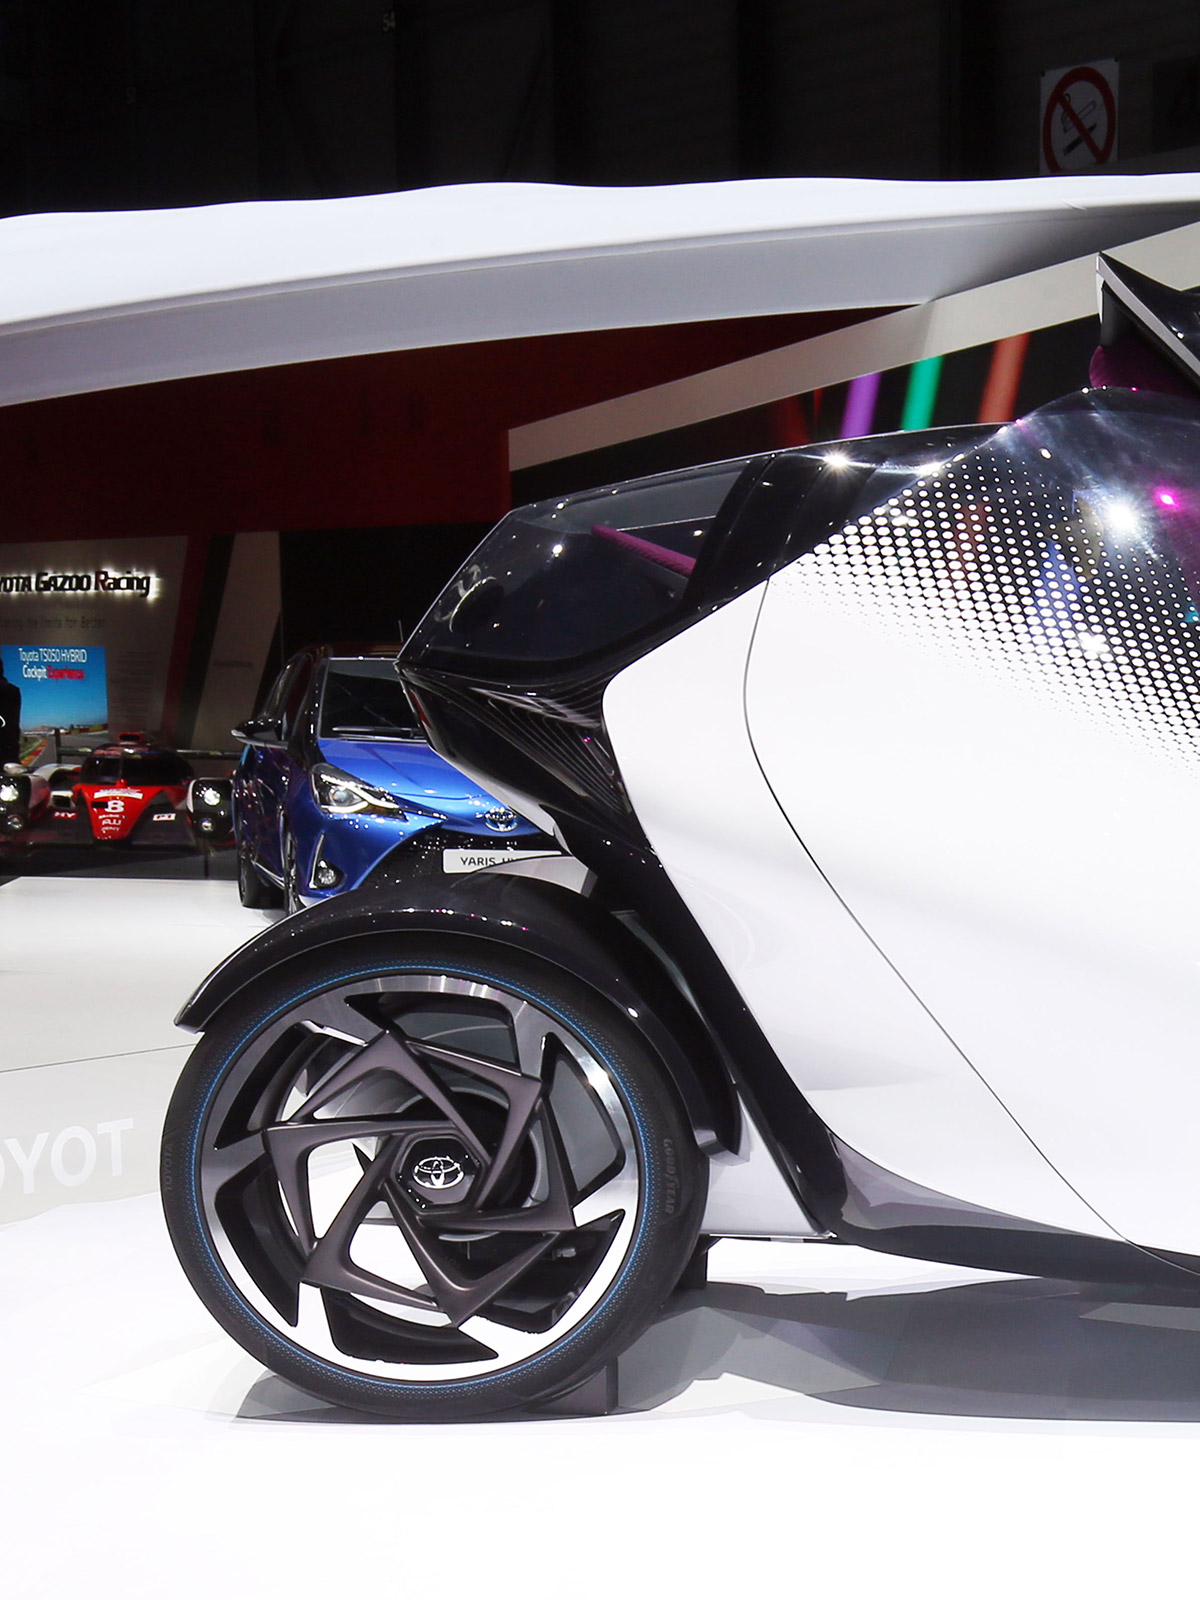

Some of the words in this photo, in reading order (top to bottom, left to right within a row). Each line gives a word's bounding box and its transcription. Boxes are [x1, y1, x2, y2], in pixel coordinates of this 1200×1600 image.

[95, 571, 150, 597] Racing
[18, 648, 39, 664] Toyota
[61, 649, 87, 663] HYBRID
[22, 664, 47, 681] Cockpit
[104, 800, 125, 812] 8
[460, 857, 496, 866] YARIS
[0, 1117, 134, 1195] YOT
[164, 1143, 173, 1192] TOYOTA
[663, 1138, 680, 1214] GOODYEAR
